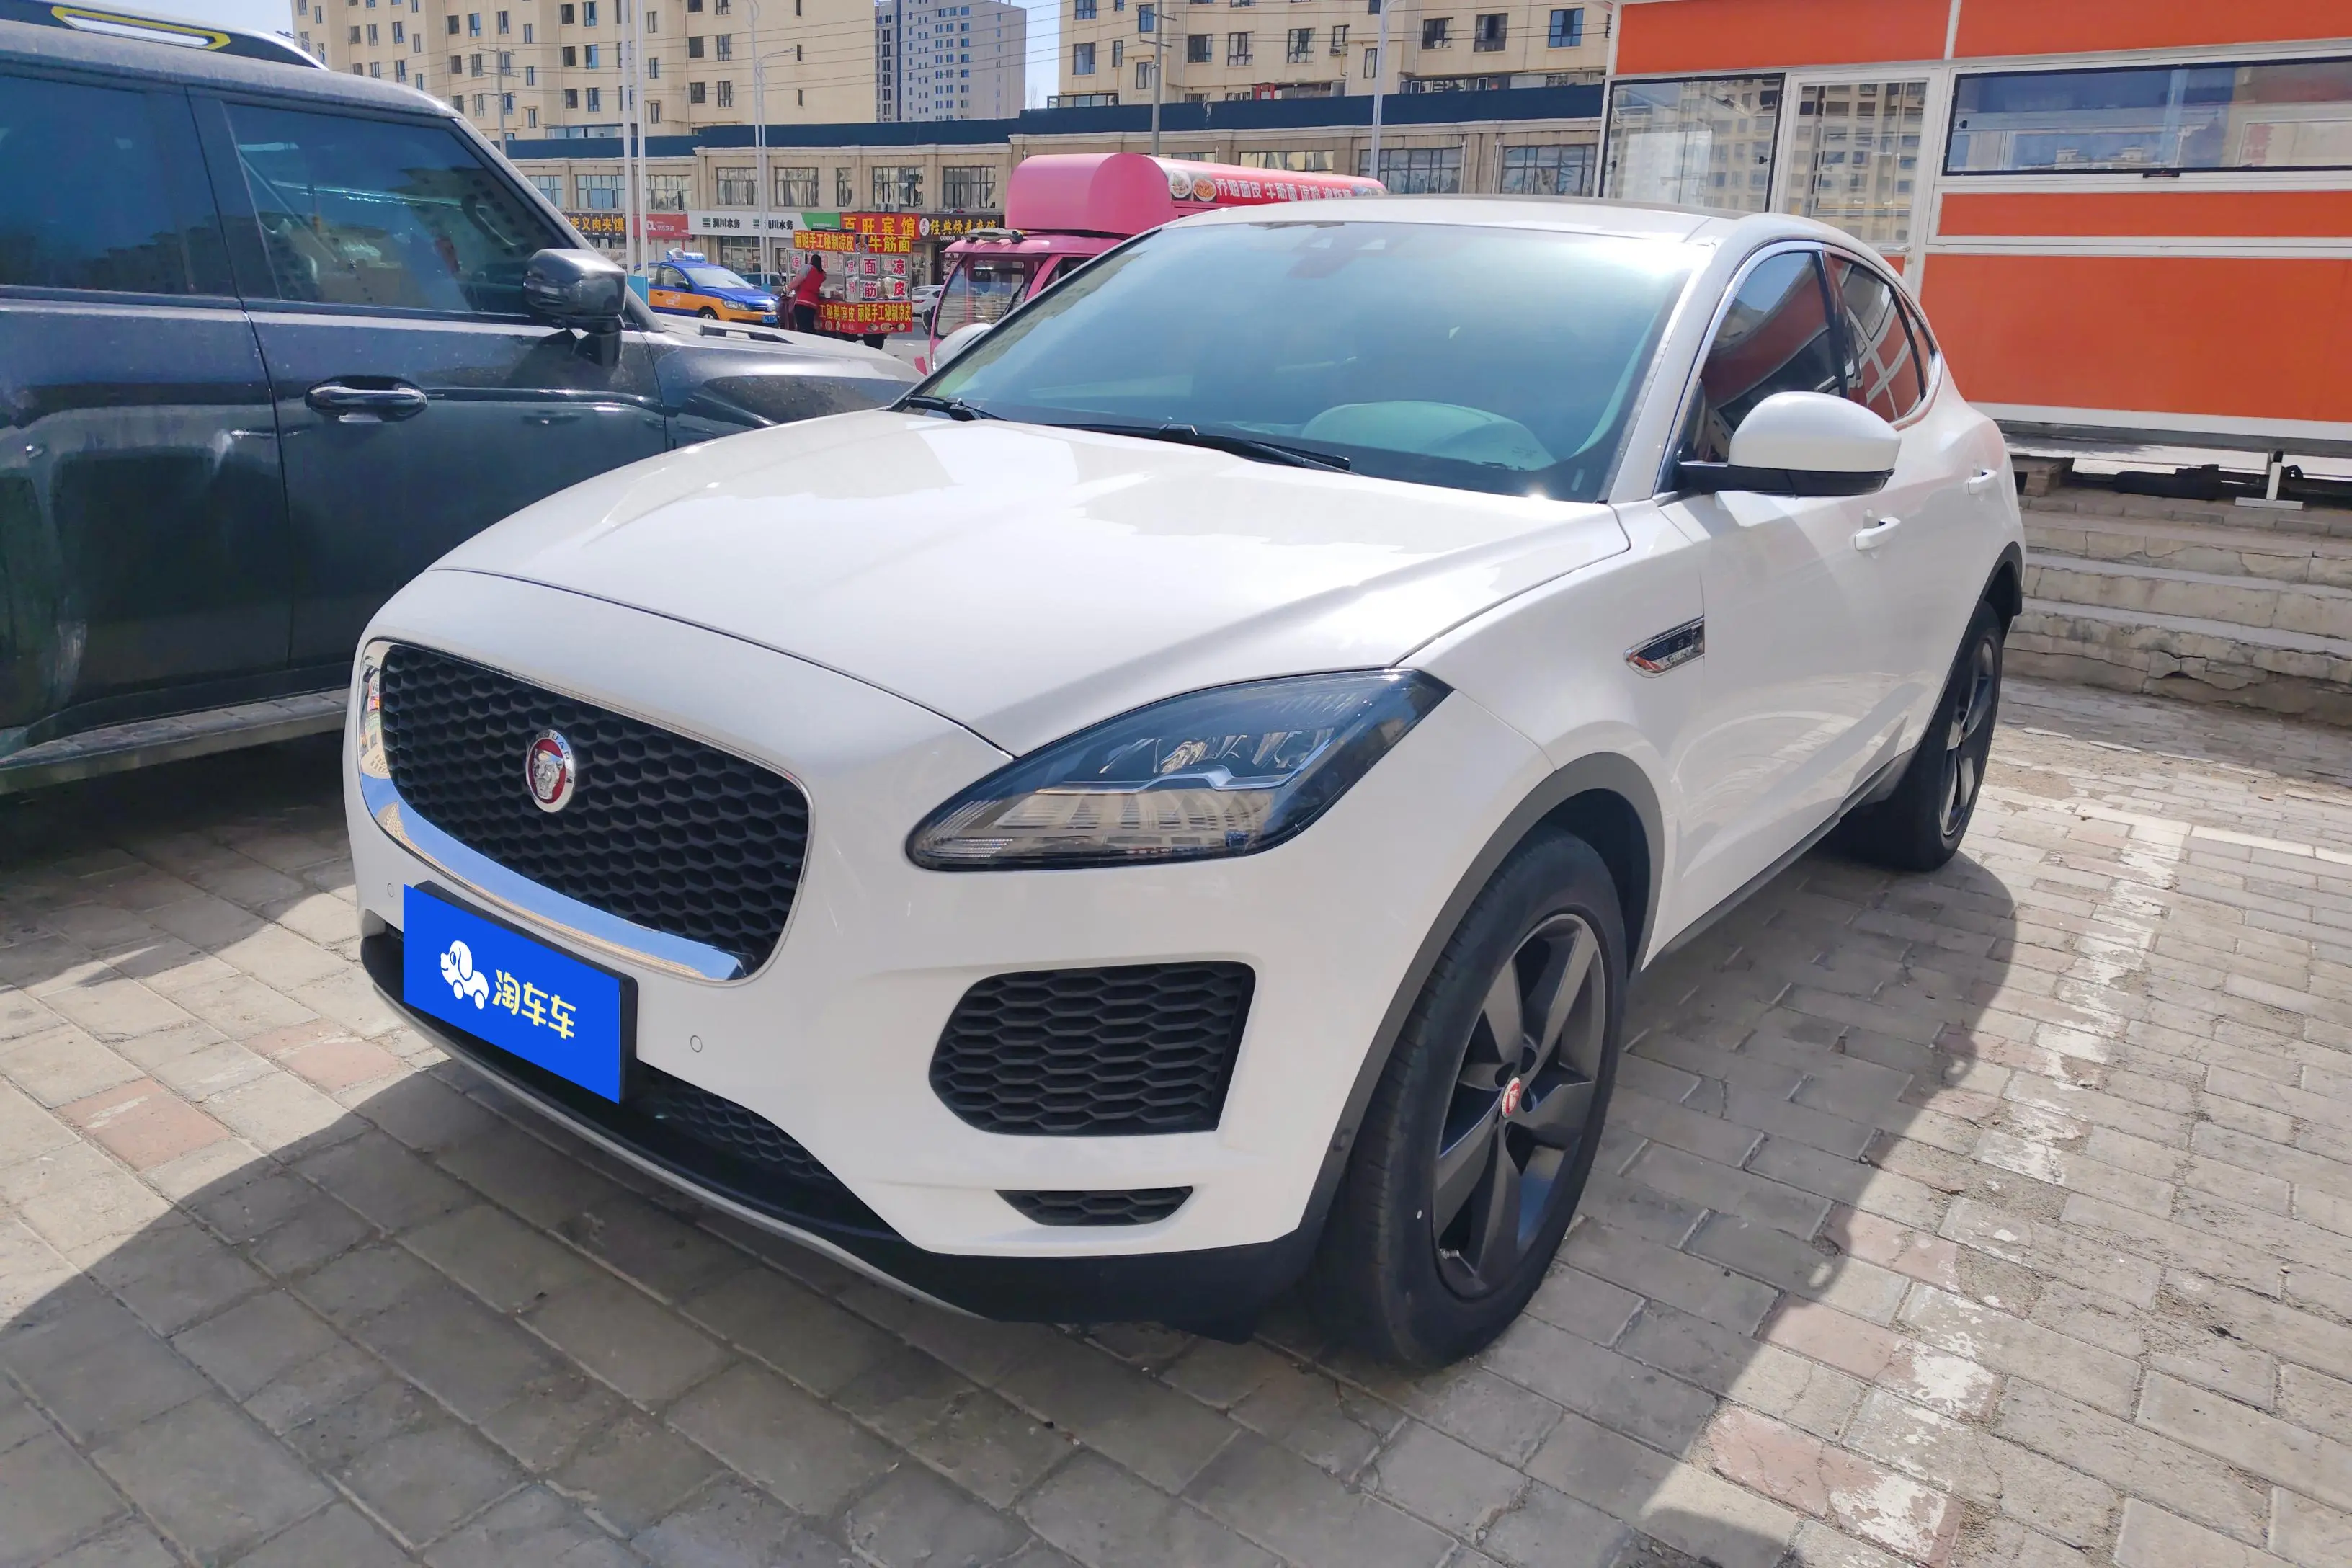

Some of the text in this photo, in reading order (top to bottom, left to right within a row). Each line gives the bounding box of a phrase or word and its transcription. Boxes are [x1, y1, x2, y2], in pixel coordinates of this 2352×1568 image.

[794, 231, 855, 251] 丽姐手工秘制凉皮
[869, 235, 912, 253] 牛筋面
